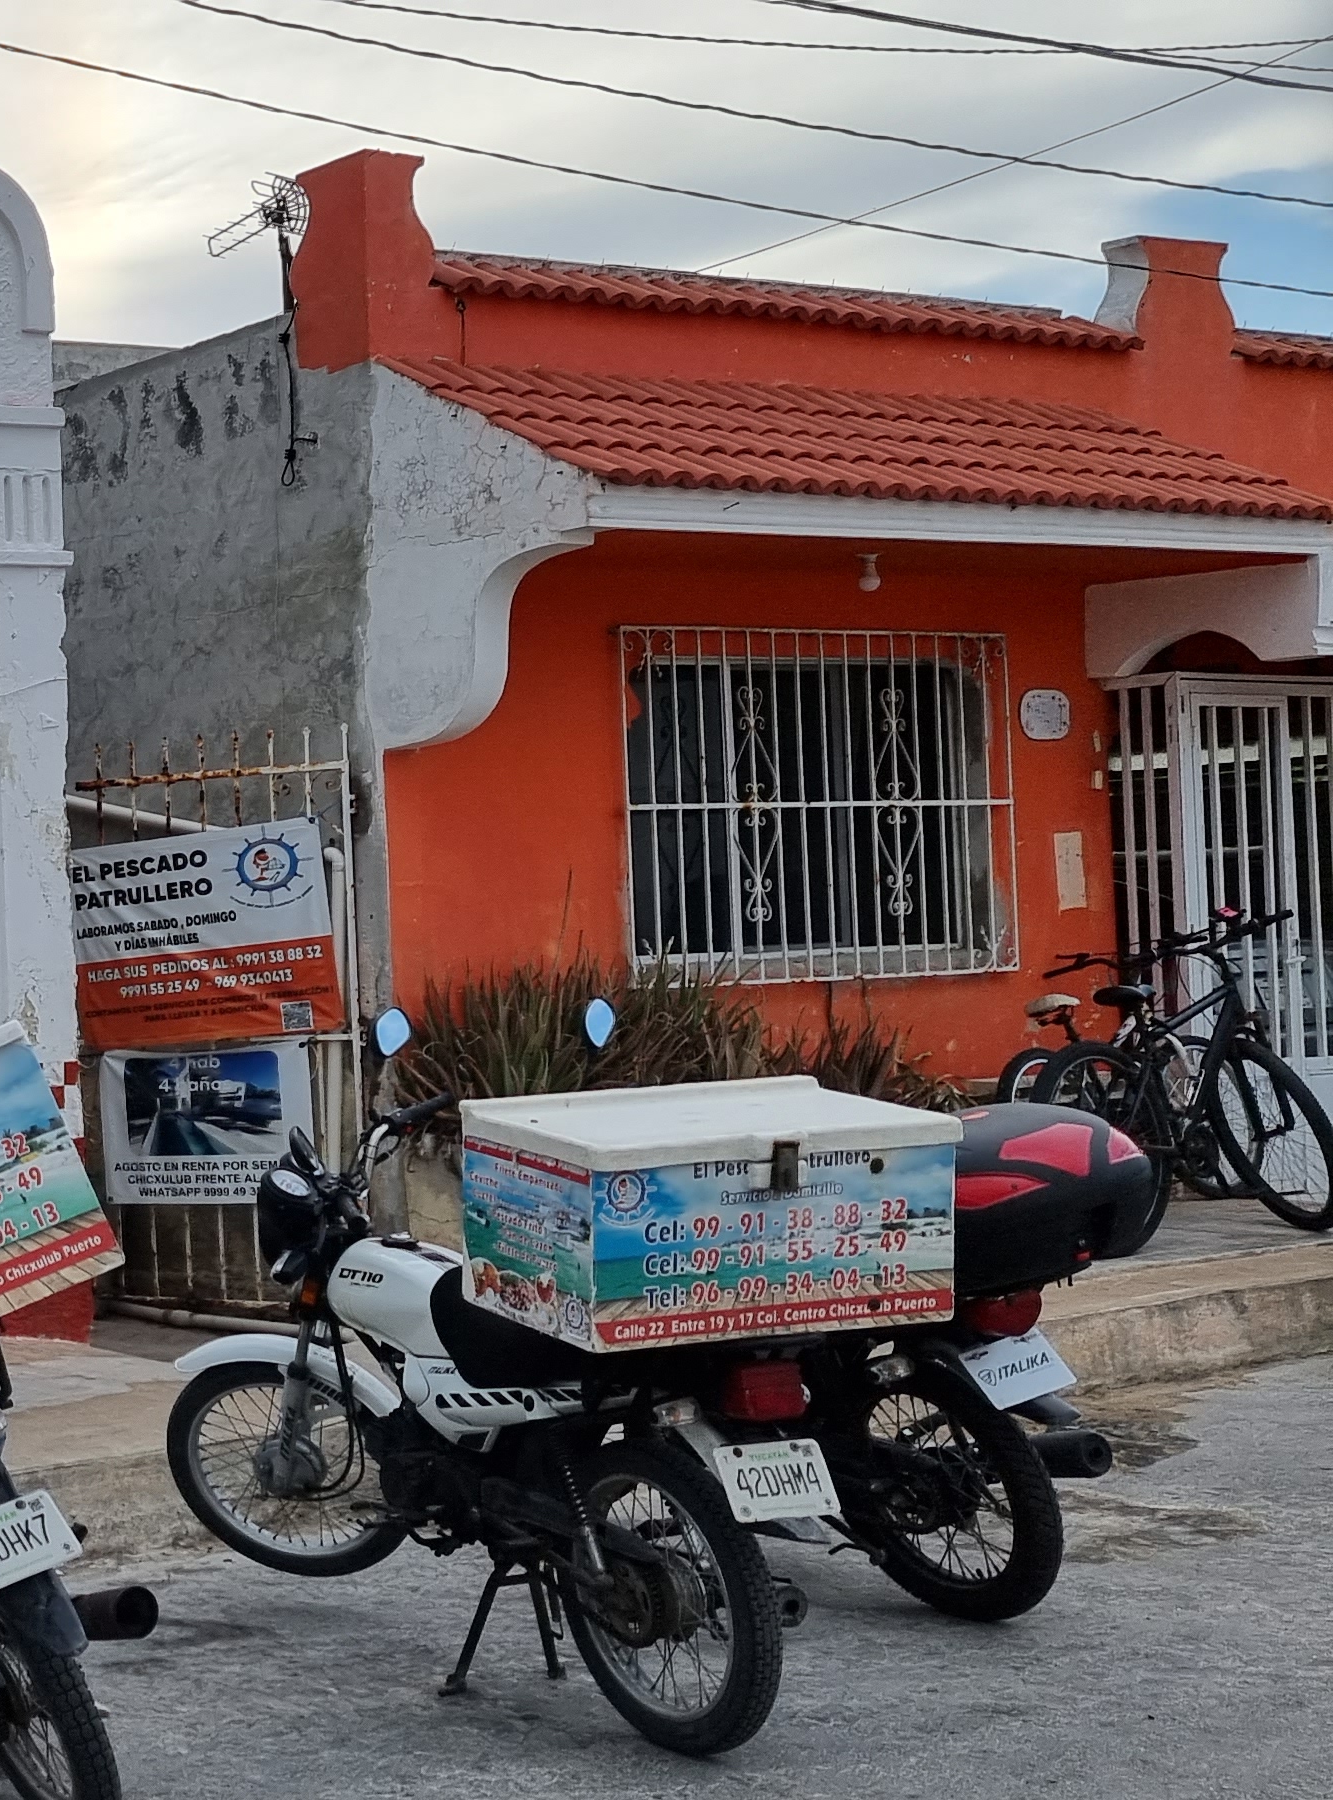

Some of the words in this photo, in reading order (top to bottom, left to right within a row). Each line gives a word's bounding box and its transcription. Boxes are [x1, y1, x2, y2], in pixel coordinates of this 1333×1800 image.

[73, 866, 95, 883] EL
[100, 849, 208, 880] PESCADO
[75, 877, 213, 911] PATRULLERO
[77, 922, 135, 940] LABORAMOS
[137, 917, 178, 932] SABADO
[186, 910, 236, 927] DOMINGO
[115, 940, 123, 951] Y
[88, 966, 122, 983] HAGA
[123, 965, 148, 979] SUS
[153, 958, 209, 975] PEDIDOS
[213, 957, 229, 969] AL
[236, 953, 264, 968] 9991
[269, 951, 284, 965] 38
[288, 949, 304, 963] 88
[307, 945, 323, 960] 32
[120, 984, 148, 998] 9991
[150, 982, 165, 996] 55
[167, 981, 182, 994] 25
[184, 979, 200, 993] 49
[1, 1134, 29, 1160] 32
[18, 1166, 42, 1192] 49
[128, 1175, 192, 1185] CHICXULUB
[195, 1174, 242, 1184] FRENTE
[164, 1162, 179, 1172] EN
[182, 1161, 220, 1172] RENTA
[223, 1161, 249, 1171] POR
[139, 1186, 201, 1198] WHATSAPP
[234, 1186, 247, 1197] 49
[644, 1221, 686, 1243] Cel:
[692, 1217, 720, 1240] 99
[740, 1211, 765, 1234] 91
[787, 1207, 813, 1230] 38
[833, 1203, 860, 1225] 88
[880, 1199, 908, 1221] 32
[5, 1250, 62, 1281] Chicxulub
[63, 1235, 102, 1258] Puerto
[997, 1351, 1050, 1380] ITALIKA
[736, 1461, 822, 1499] 42DHM4
